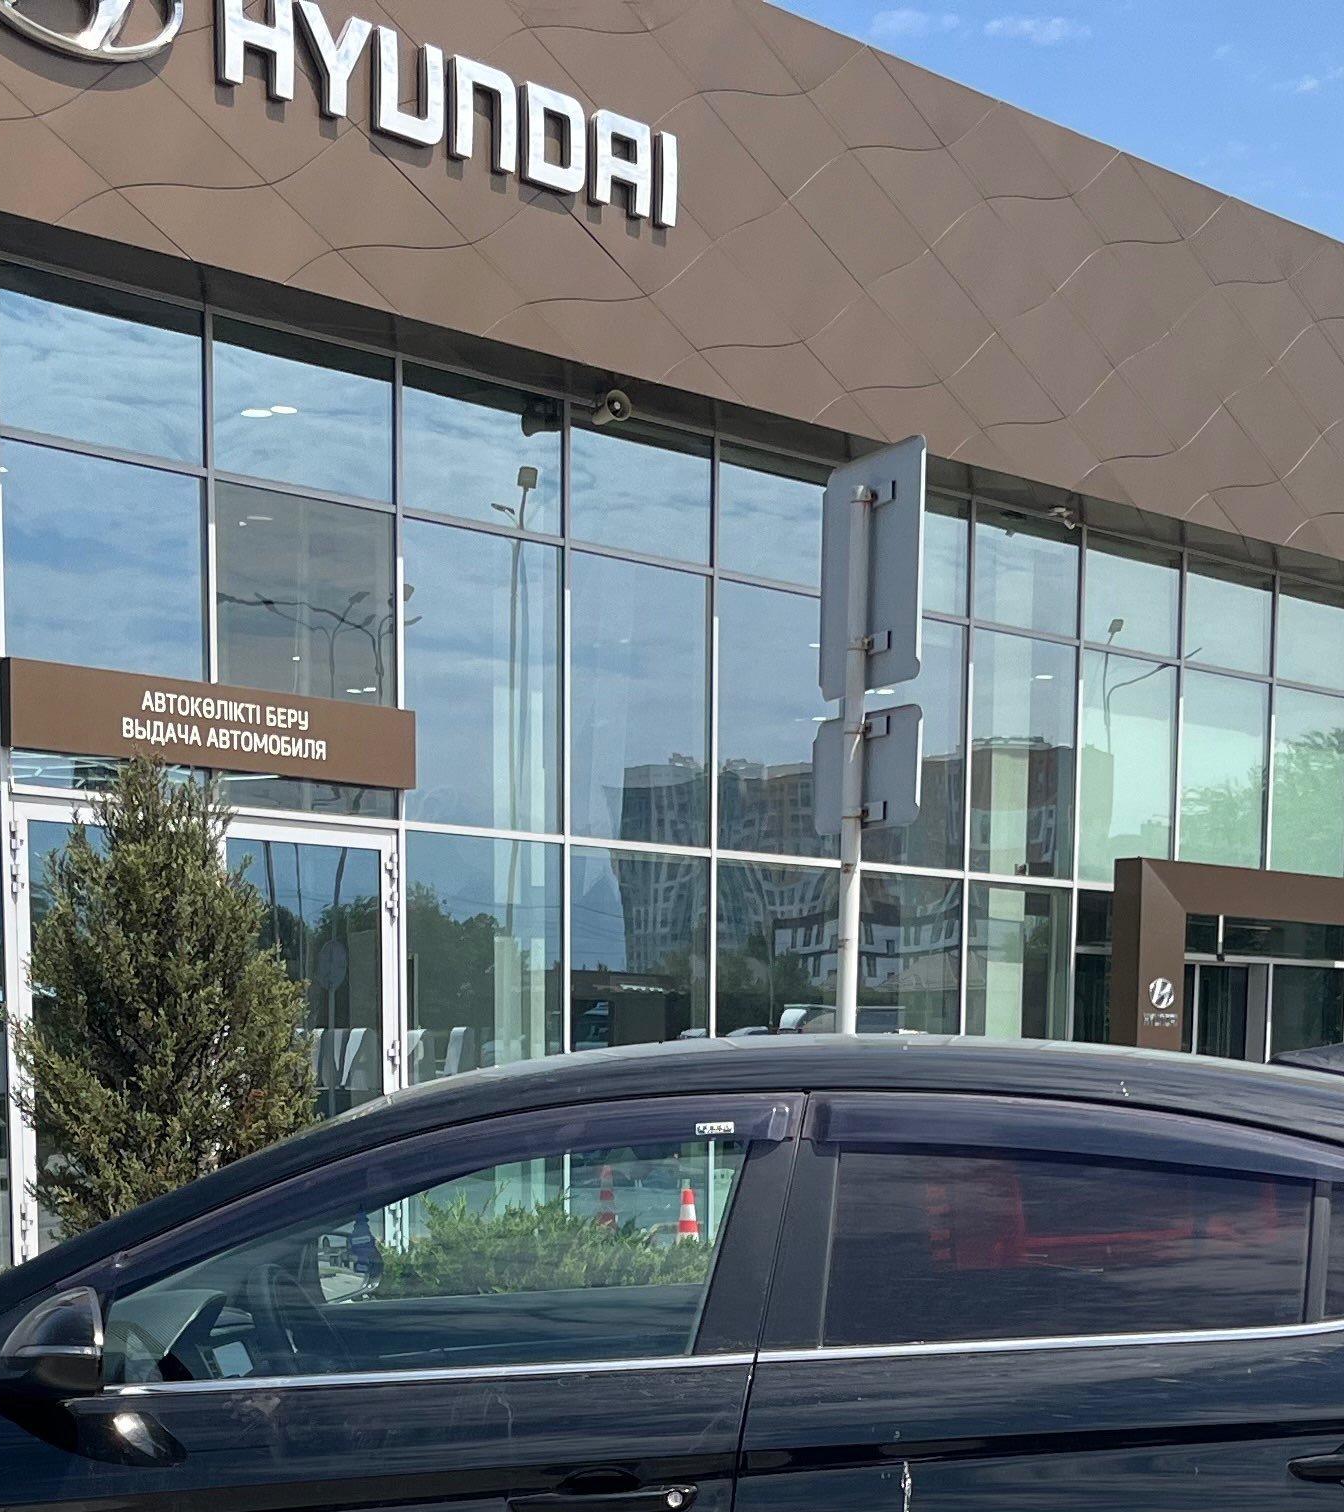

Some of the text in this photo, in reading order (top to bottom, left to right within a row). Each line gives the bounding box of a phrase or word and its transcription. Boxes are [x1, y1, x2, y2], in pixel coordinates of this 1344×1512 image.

[214, 0, 678, 229] HYUNDAI
[141, 690, 309, 731] АВТОКӨЛІКТІ БЕРУ
[122, 716, 327, 760] ВЫДАЧА АВТОМОБИЛЯ
